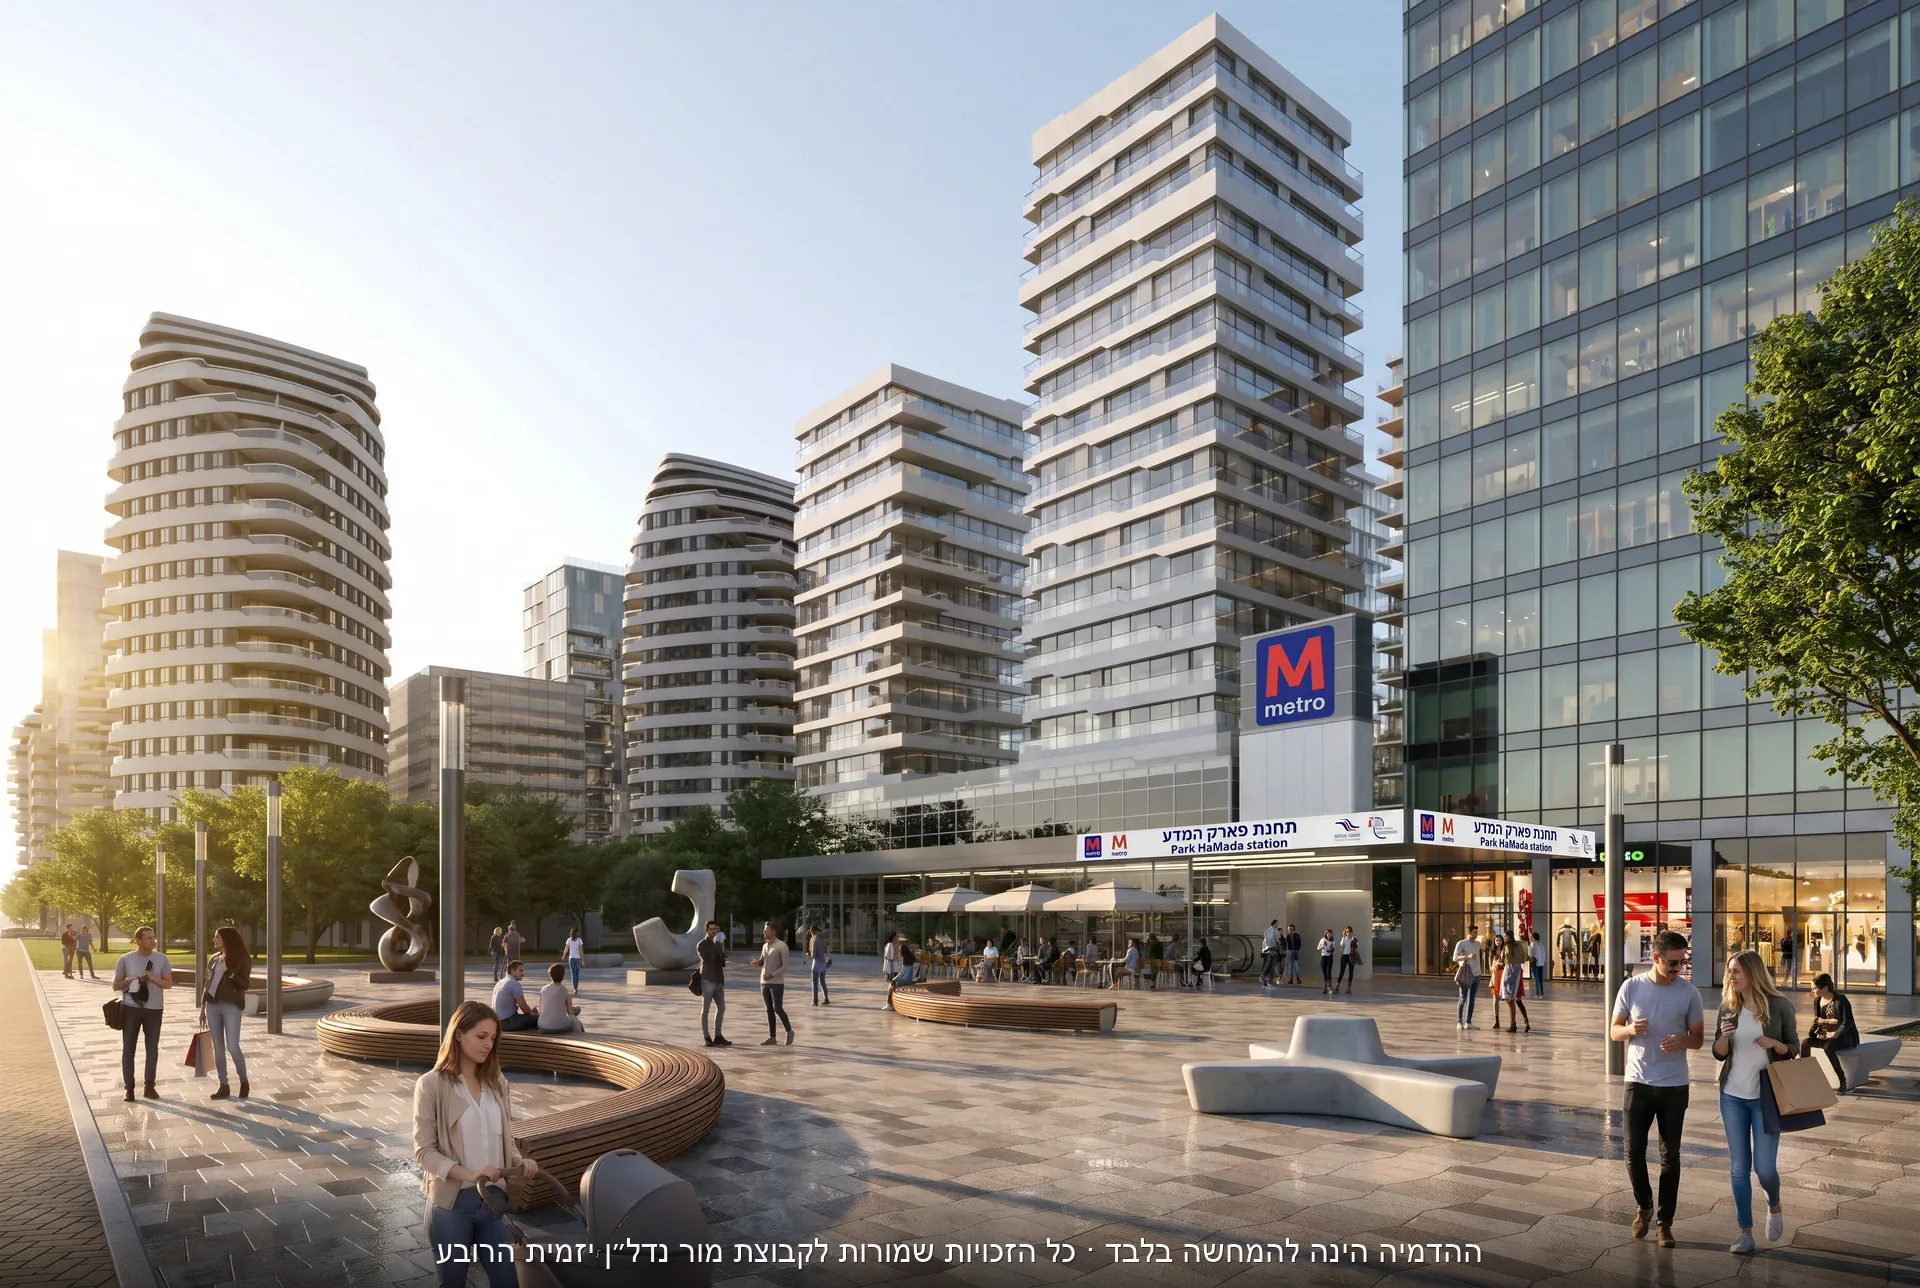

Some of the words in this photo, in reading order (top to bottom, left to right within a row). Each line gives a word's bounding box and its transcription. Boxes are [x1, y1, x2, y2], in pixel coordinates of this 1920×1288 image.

[1265, 635, 1325, 698] M
[1265, 697, 1326, 718] metro
[1253, 821, 1297, 837] תחנת
[1422, 816, 1433, 833] M
[1442, 817, 1454, 835] M
[1473, 821, 1503, 835] המדע
[1505, 825, 1531, 839] פארק
[1162, 829, 1203, 843] המדע
[1207, 825, 1249, 842] פארק
[1533, 828, 1557, 841] תחנת
[1086, 837, 1100, 851] M
[1111, 834, 1128, 850] M
[1171, 844, 1196, 855] Park
[1198, 840, 1244, 853] HaMada
[1246, 838, 1288, 850] station
[1480, 837, 1498, 848] Park
[1499, 839, 1529, 850] HaMada
[1529, 842, 1553, 852] station
